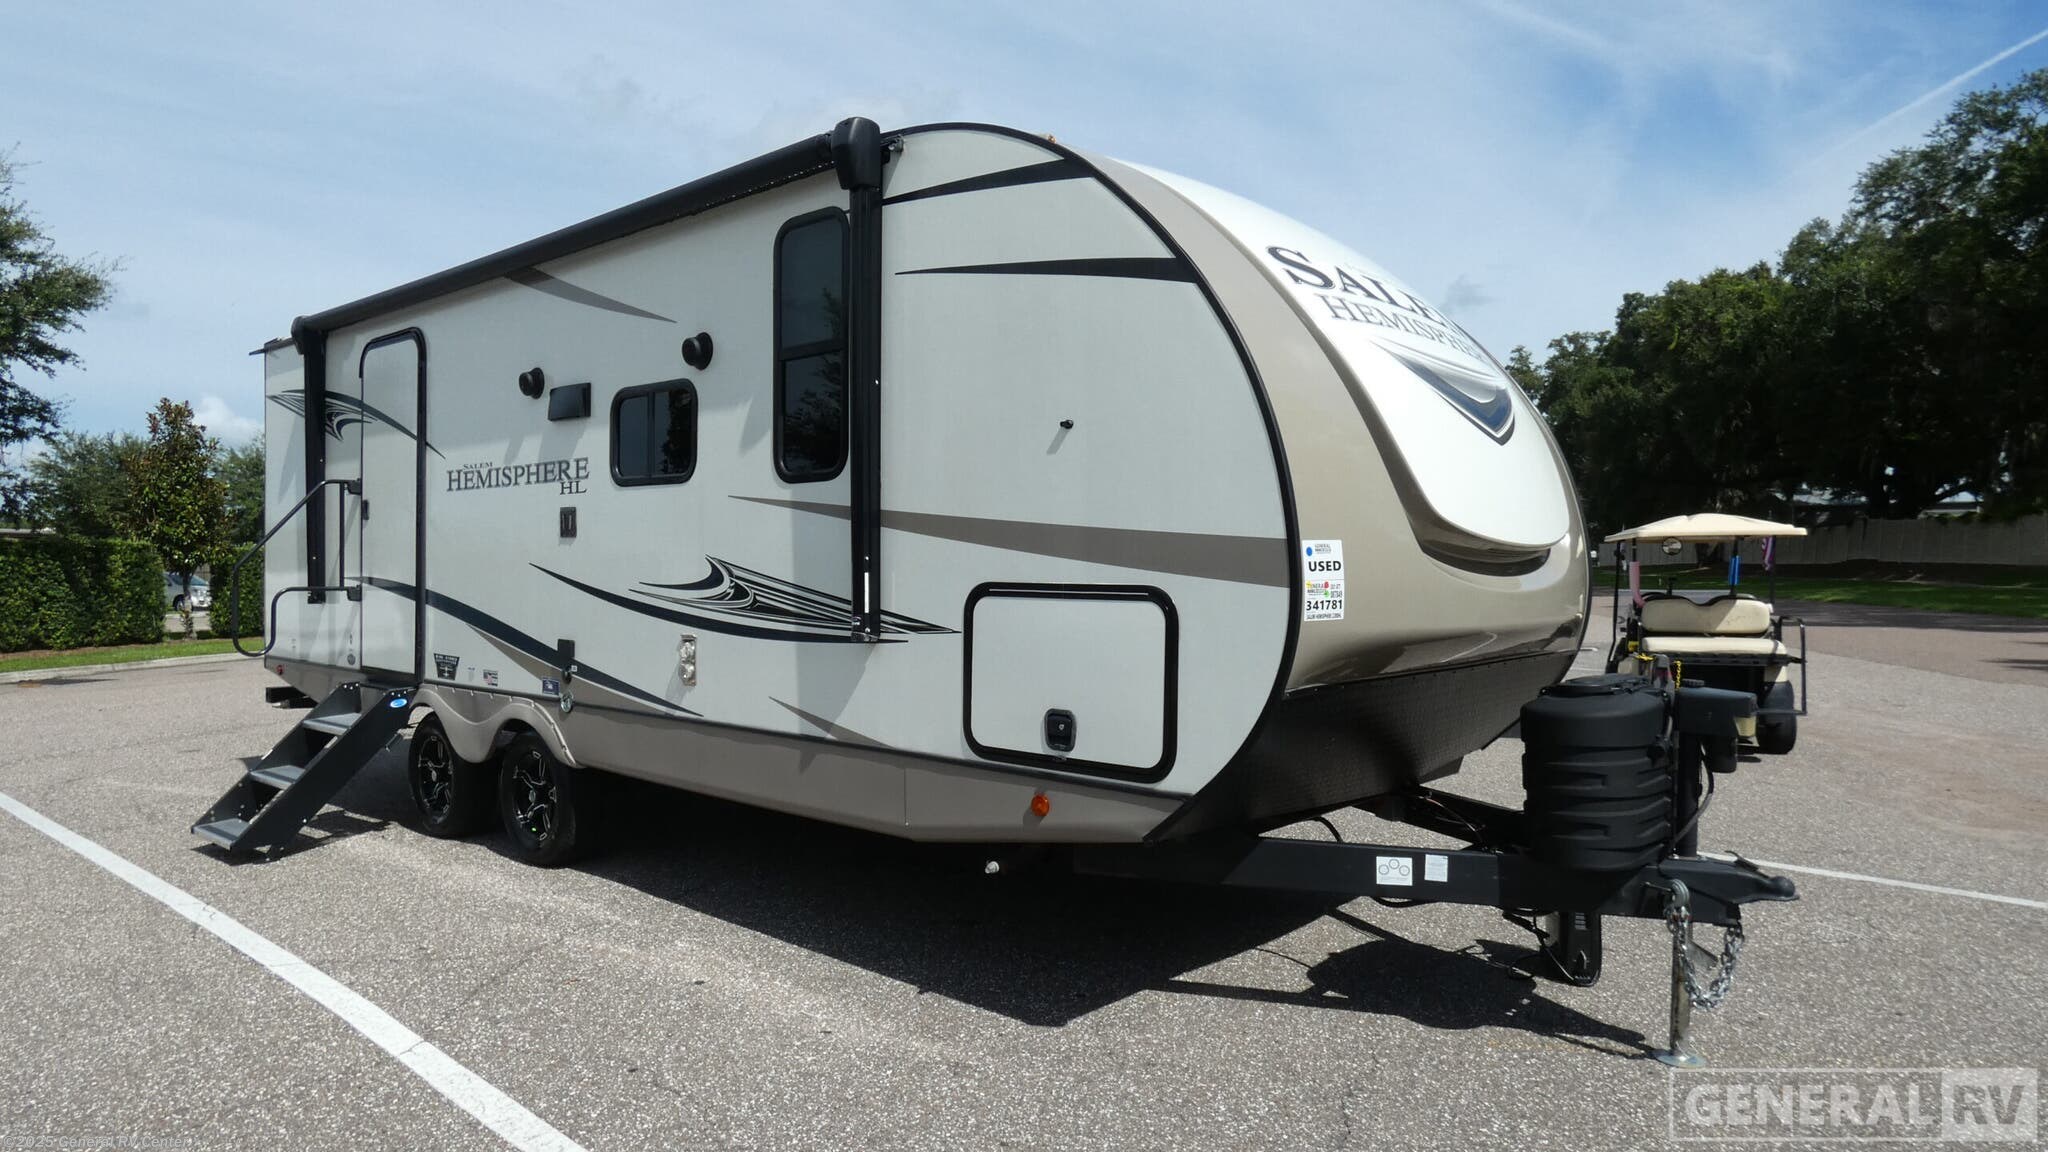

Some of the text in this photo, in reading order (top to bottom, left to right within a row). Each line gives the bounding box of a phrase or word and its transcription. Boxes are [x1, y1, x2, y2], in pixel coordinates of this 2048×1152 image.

[462, 461, 493, 470] SALEM
[446, 457, 590, 492] HEMISPHERE
[560, 481, 587, 495] HL
[1308, 560, 1342, 572] USED
[1306, 599, 1343, 611] 341781
